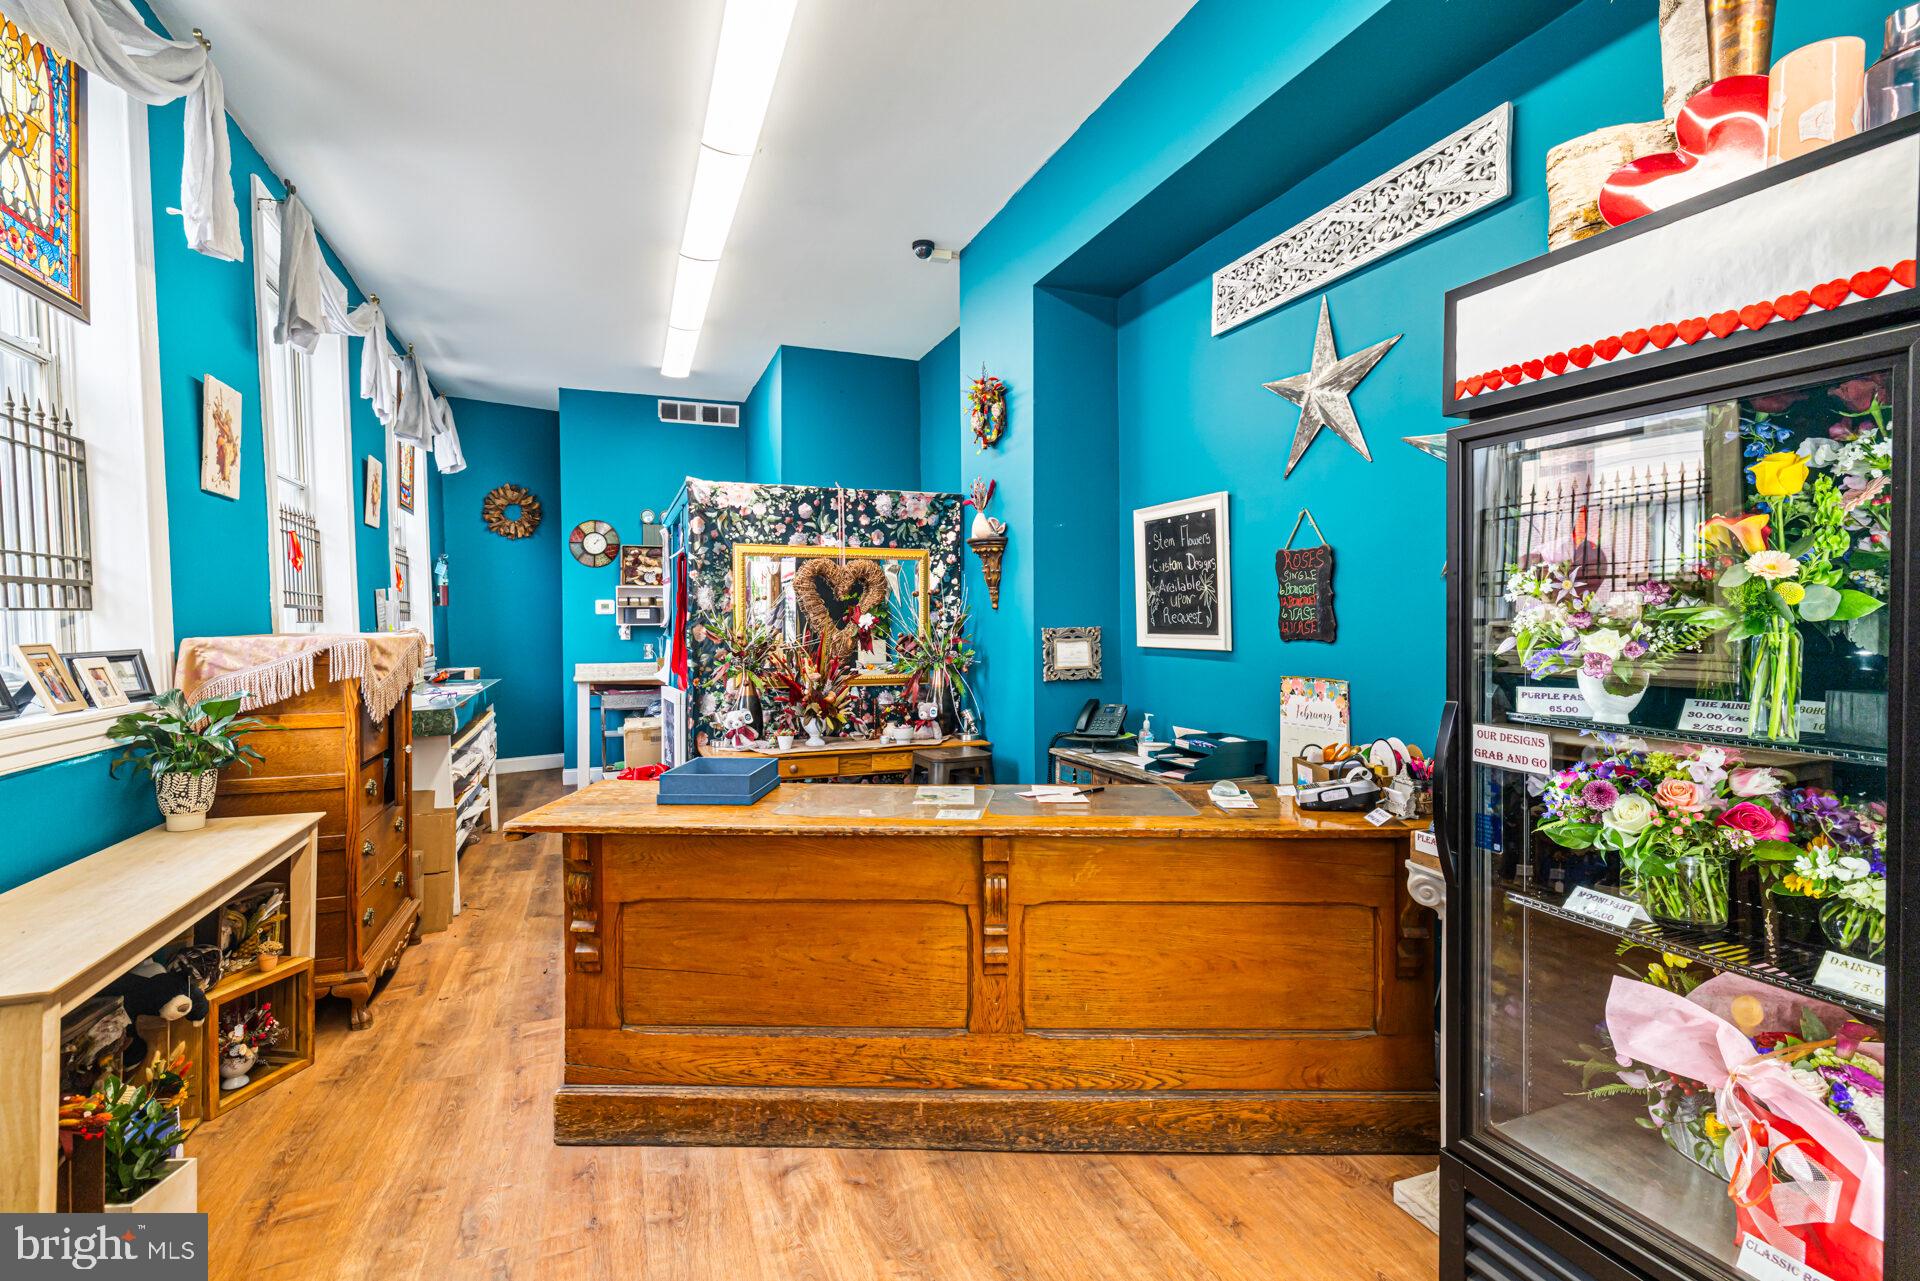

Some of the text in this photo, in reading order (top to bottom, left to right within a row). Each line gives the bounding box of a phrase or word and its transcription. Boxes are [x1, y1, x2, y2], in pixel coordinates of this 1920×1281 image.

[1153, 524, 1211, 551] Stem Flowers
[1152, 553, 1216, 573] Custom Designs
[1283, 549, 1325, 570] ROSES
[1282, 570, 1317, 582] SINGLE
[1163, 606, 1203, 624] Request
[1289, 607, 1317, 620] VASE
[1521, 692, 1560, 700] PURPLE
[1694, 700, 1718, 708] THE
[1296, 704, 1333, 726] February
[1477, 729, 1545, 748] OUR DESIGNS
[1692, 723, 1743, 734] 2/55.00
[1474, 748, 1547, 769] GRAB AND GO
[1577, 890, 1635, 914] MOONLIGHT
[1830, 956, 1884, 977] DAINTY
[1745, 1239, 1801, 1276] CLASSIC
